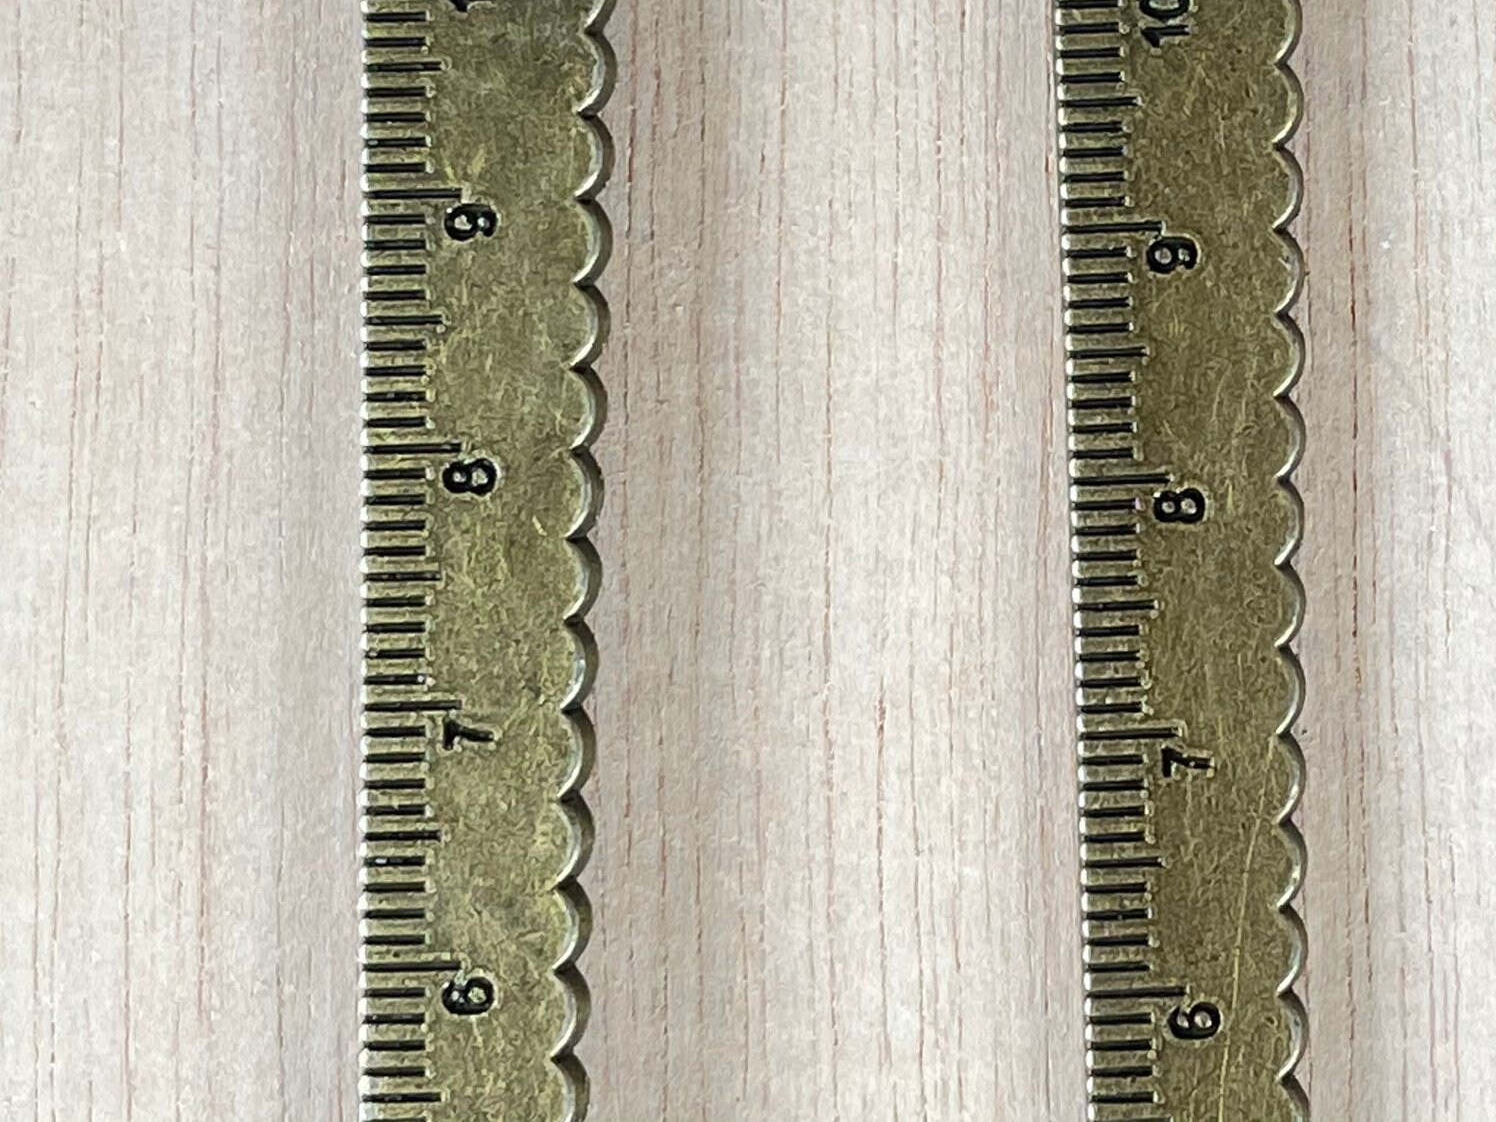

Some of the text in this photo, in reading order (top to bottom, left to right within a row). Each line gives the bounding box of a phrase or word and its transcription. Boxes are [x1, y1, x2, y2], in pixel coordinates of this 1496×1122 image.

[444, 203, 497, 242] 9
[1145, 235, 1197, 275] 9
[442, 458, 498, 497] 8
[1152, 487, 1208, 525] 8
[442, 718, 495, 750] 7
[1160, 745, 1214, 778] 7
[442, 974, 495, 1016] 6
[1168, 1002, 1221, 1040] 6
